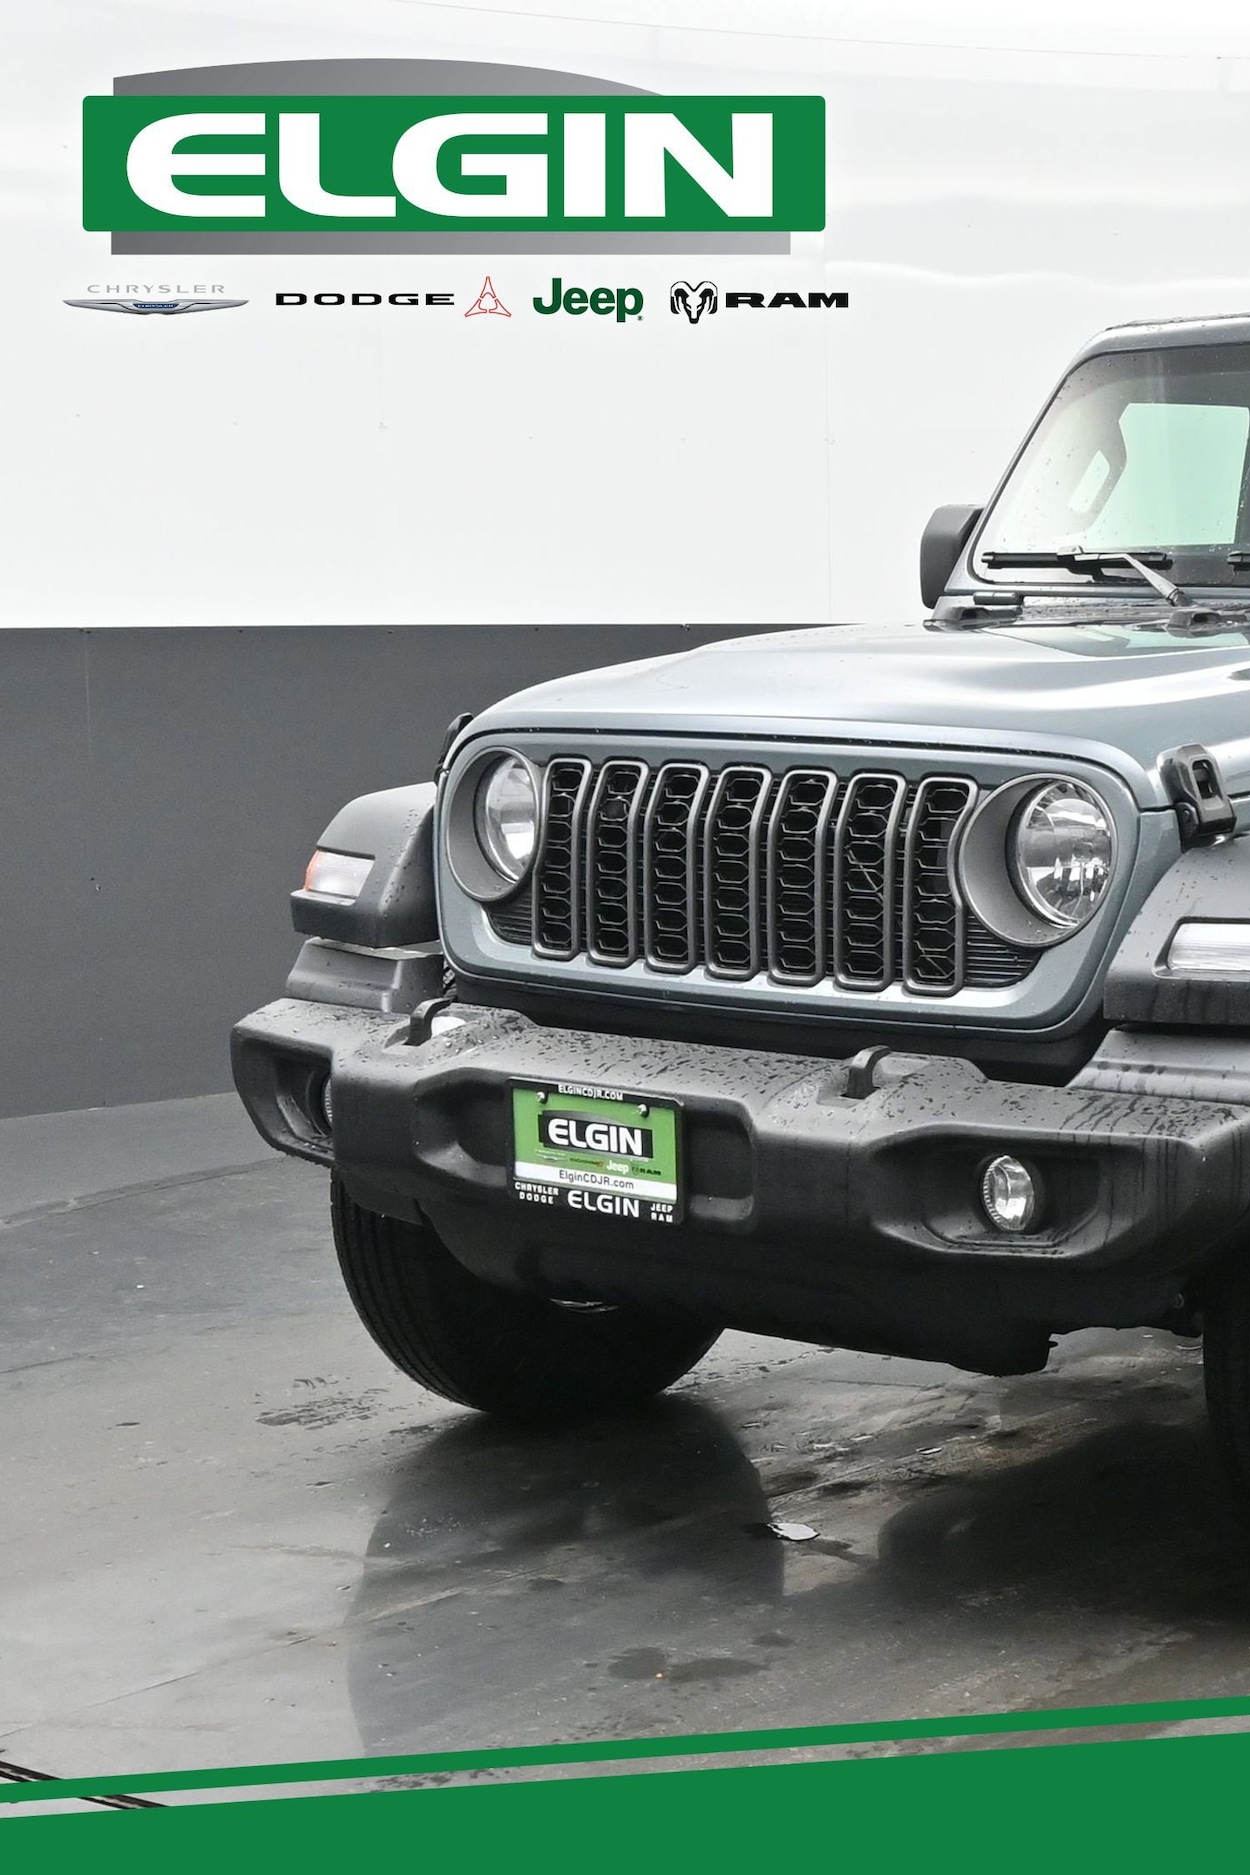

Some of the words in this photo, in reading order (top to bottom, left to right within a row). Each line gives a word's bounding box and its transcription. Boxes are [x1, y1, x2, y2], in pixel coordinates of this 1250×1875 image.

[558, 1084, 624, 1101] ELGINCDJR.COM
[548, 1118, 643, 1156] ELGIN
[606, 1160, 629, 1175] Jeep
[559, 1169, 634, 1190] ElginCDJR.com
[515, 1182, 559, 1196] CHRYSLER
[519, 1193, 554, 1205] DODGE
[567, 1189, 640, 1218] ELGIN
[650, 1202, 673, 1213] JEEP
[651, 1212, 673, 1223] RAM
